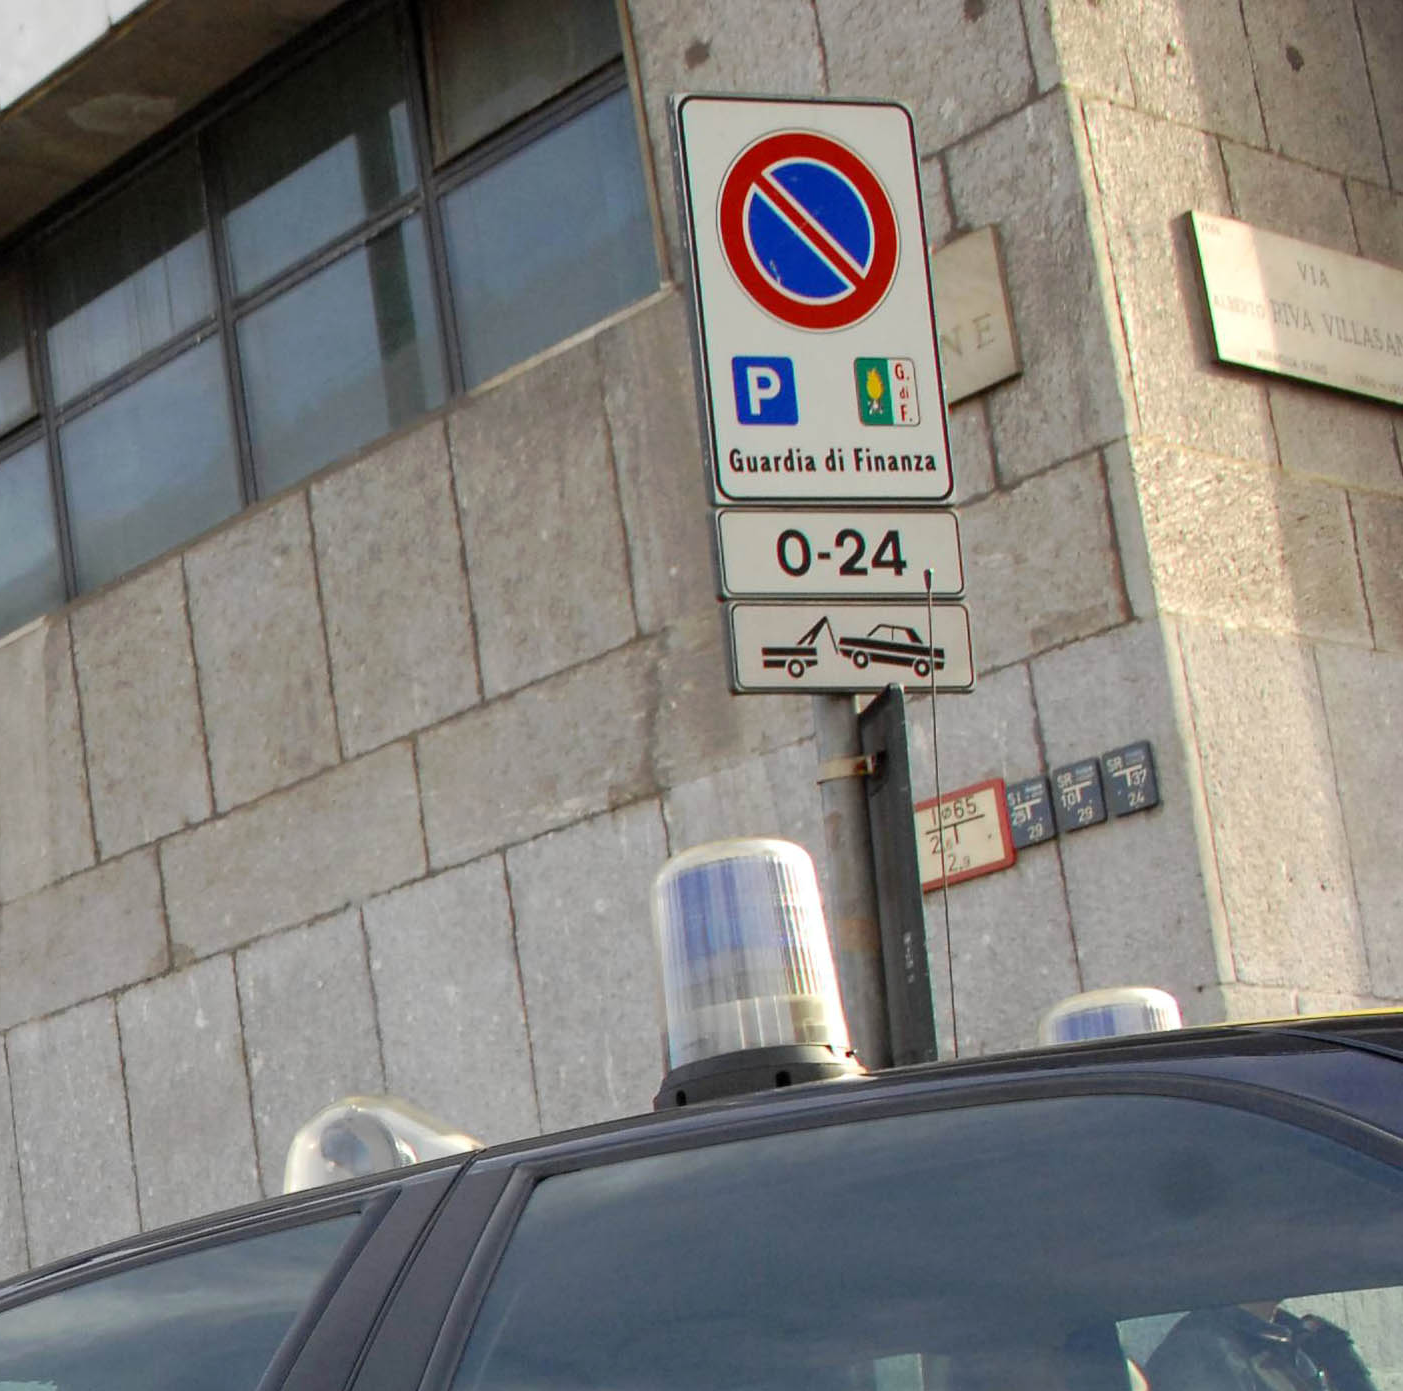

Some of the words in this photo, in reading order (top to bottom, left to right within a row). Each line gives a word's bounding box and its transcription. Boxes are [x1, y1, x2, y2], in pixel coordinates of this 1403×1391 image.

[1297, 260, 1330, 289] VIA
[1269, 298, 1315, 335] RIVA
[746, 365, 782, 416] P
[899, 386, 910, 399] di
[728, 448, 817, 473] Guardia
[824, 447, 845, 472] di
[853, 447, 937, 472] Finanza
[776, 528, 908, 577] 0-24
